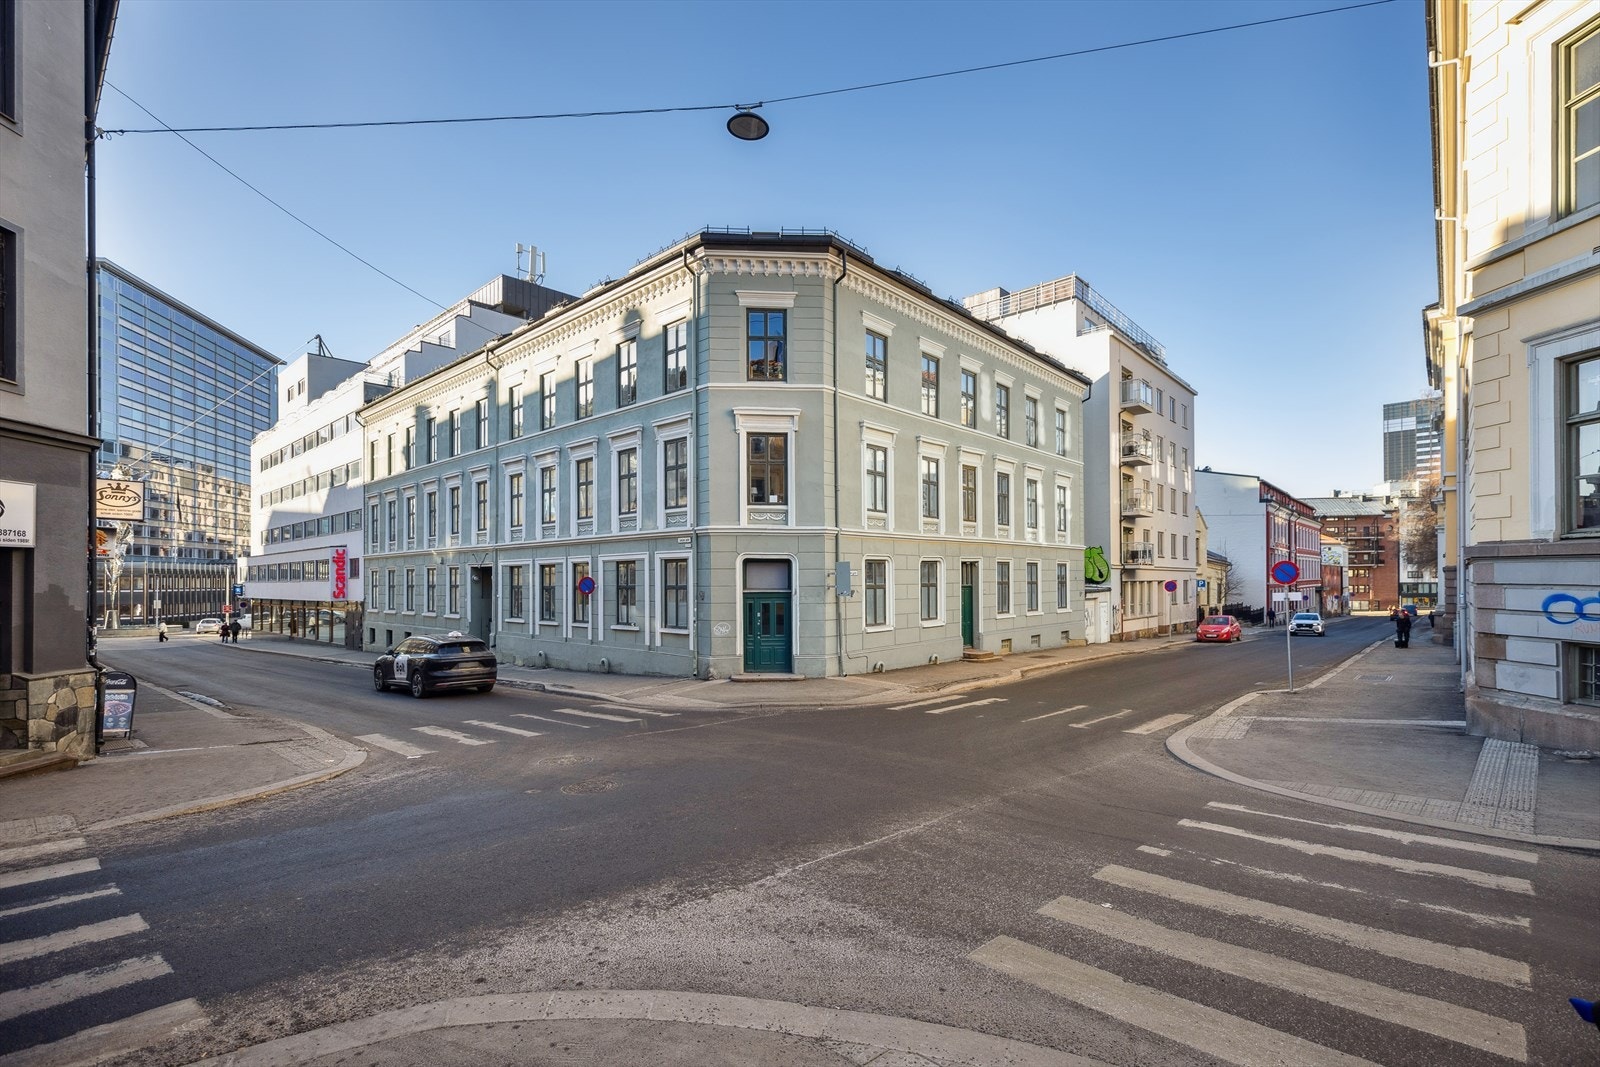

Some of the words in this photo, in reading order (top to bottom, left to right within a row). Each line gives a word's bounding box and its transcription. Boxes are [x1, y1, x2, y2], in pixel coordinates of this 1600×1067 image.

[96, 490, 137, 503] Sonnys
[332, 548, 346, 599] Scandic
[395, 661, 406, 672] Bolt
